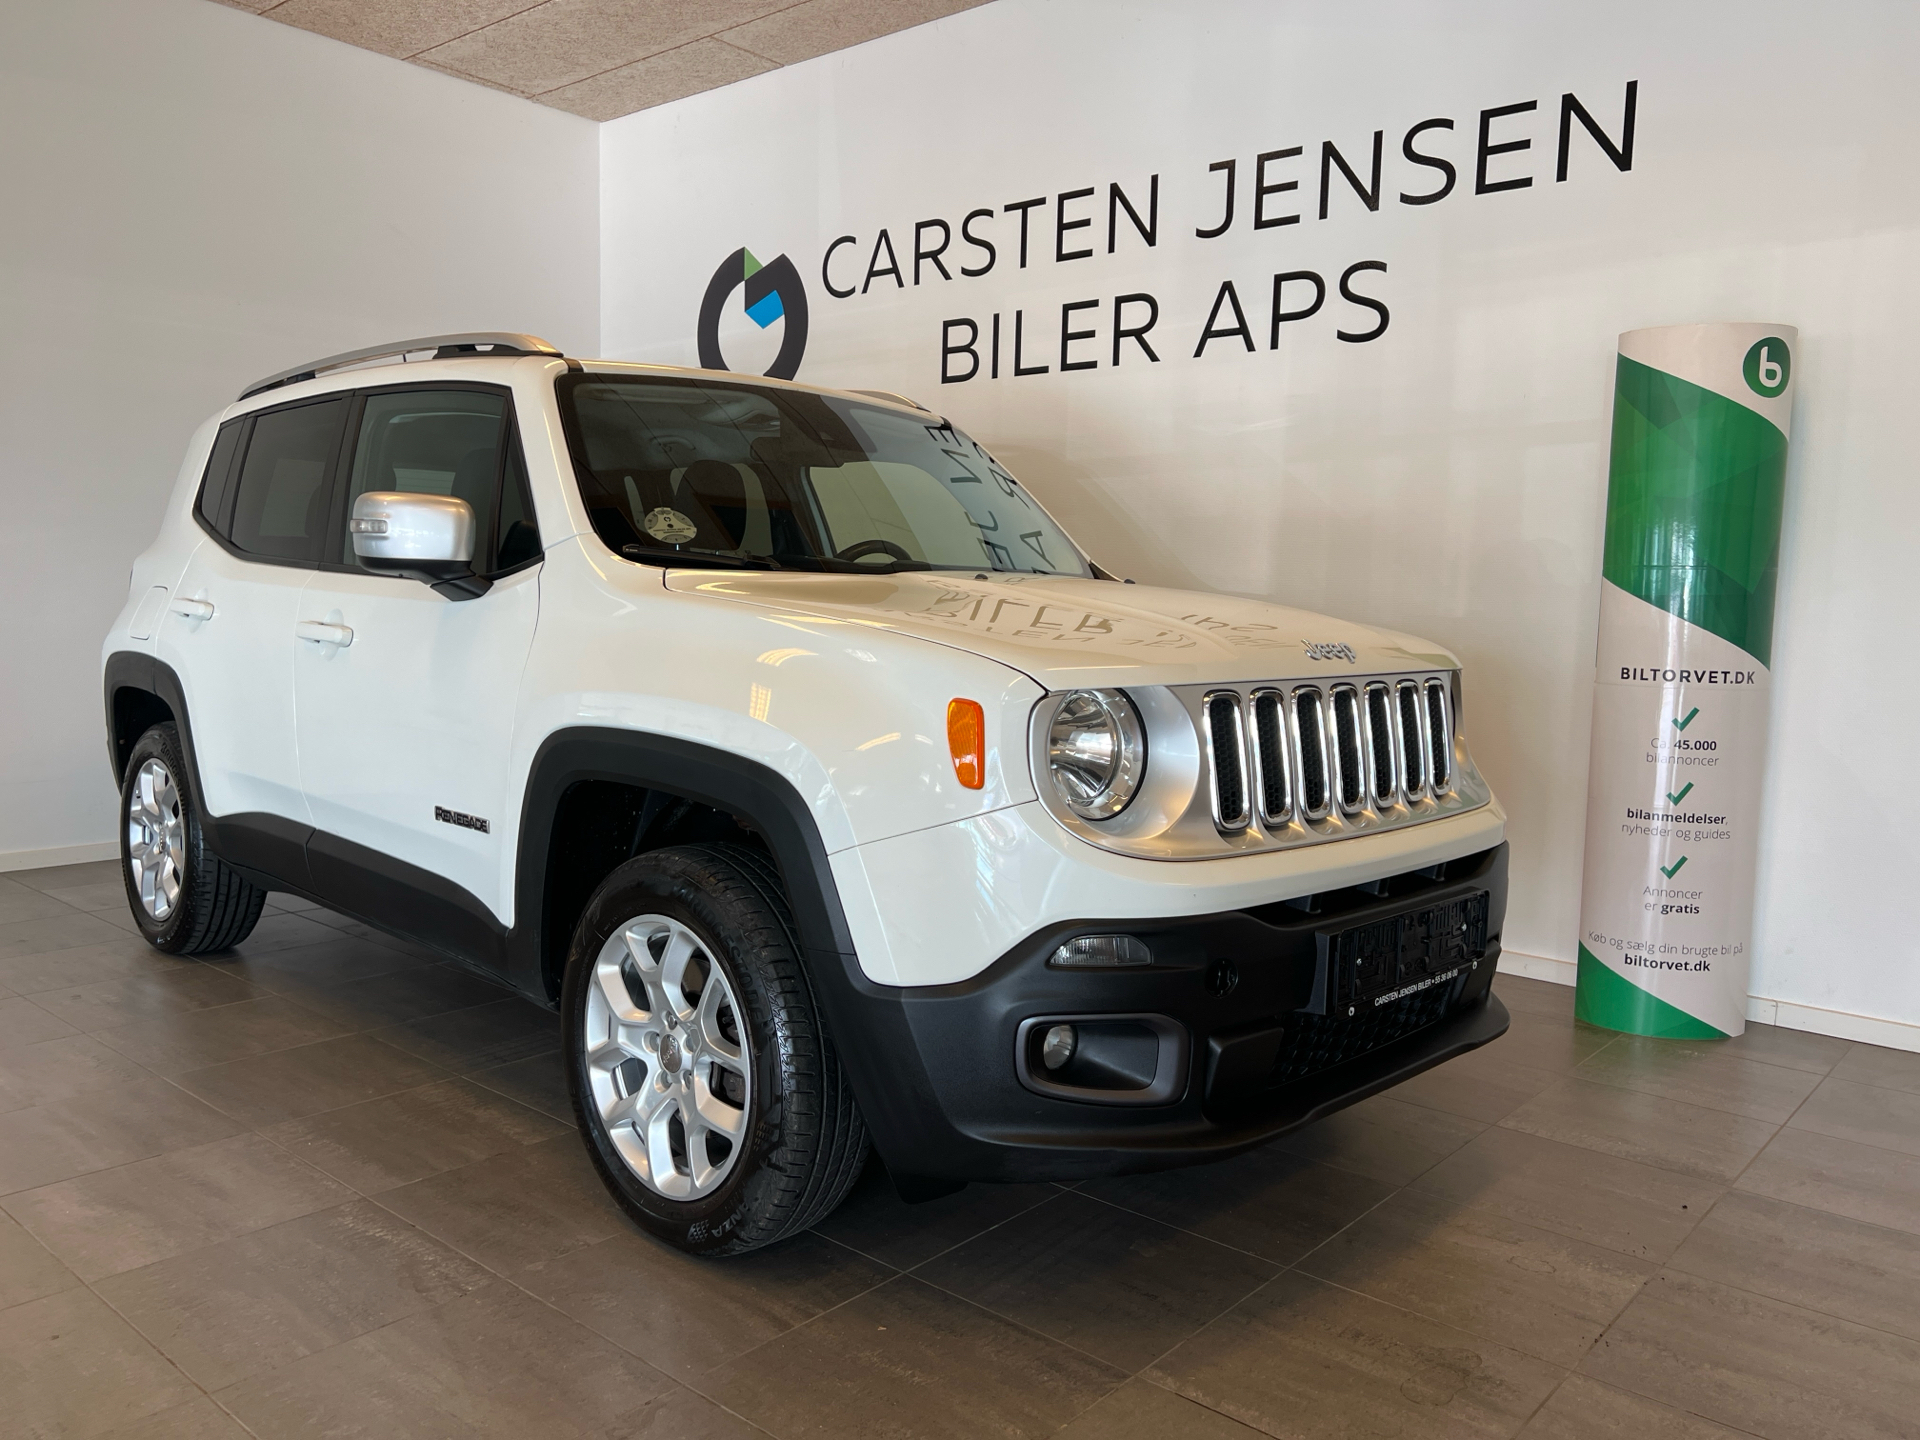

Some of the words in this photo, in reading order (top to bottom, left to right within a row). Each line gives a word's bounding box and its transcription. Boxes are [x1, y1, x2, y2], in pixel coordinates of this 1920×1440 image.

[822, 173, 1158, 299] CARSTEN
[1195, 80, 1639, 240] JENSEN
[940, 291, 1160, 385] BILER
[1193, 260, 1391, 358] APS
[1300, 638, 1357, 665] Jeep
[1620, 667, 1756, 685] BILTORVET.DK
[1673, 739, 1718, 751] 45.000
[1646, 751, 1720, 767] bilannoncer
[434, 805, 491, 835] RENEGADE
[1626, 807, 1729, 826] bilanmeldelser,
[1621, 822, 1673, 838] nyheder
[1675, 829, 1691, 842] og
[1693, 828, 1731, 842] guides
[1642, 885, 1703, 900] Annoncer
[1644, 902, 1658, 911] er
[1660, 903, 1700, 916] gratis
[1588, 930, 1607, 945] Køb
[1609, 938, 1624, 951] og
[1626, 940, 1655, 955] sælg
[1658, 941, 1678, 955] din
[1681, 943, 1719, 959] brugte
[1720, 943, 1732, 956] bil
[1733, 942, 1744, 957] på
[1623, 953, 1711, 972] biltorvet.dk
